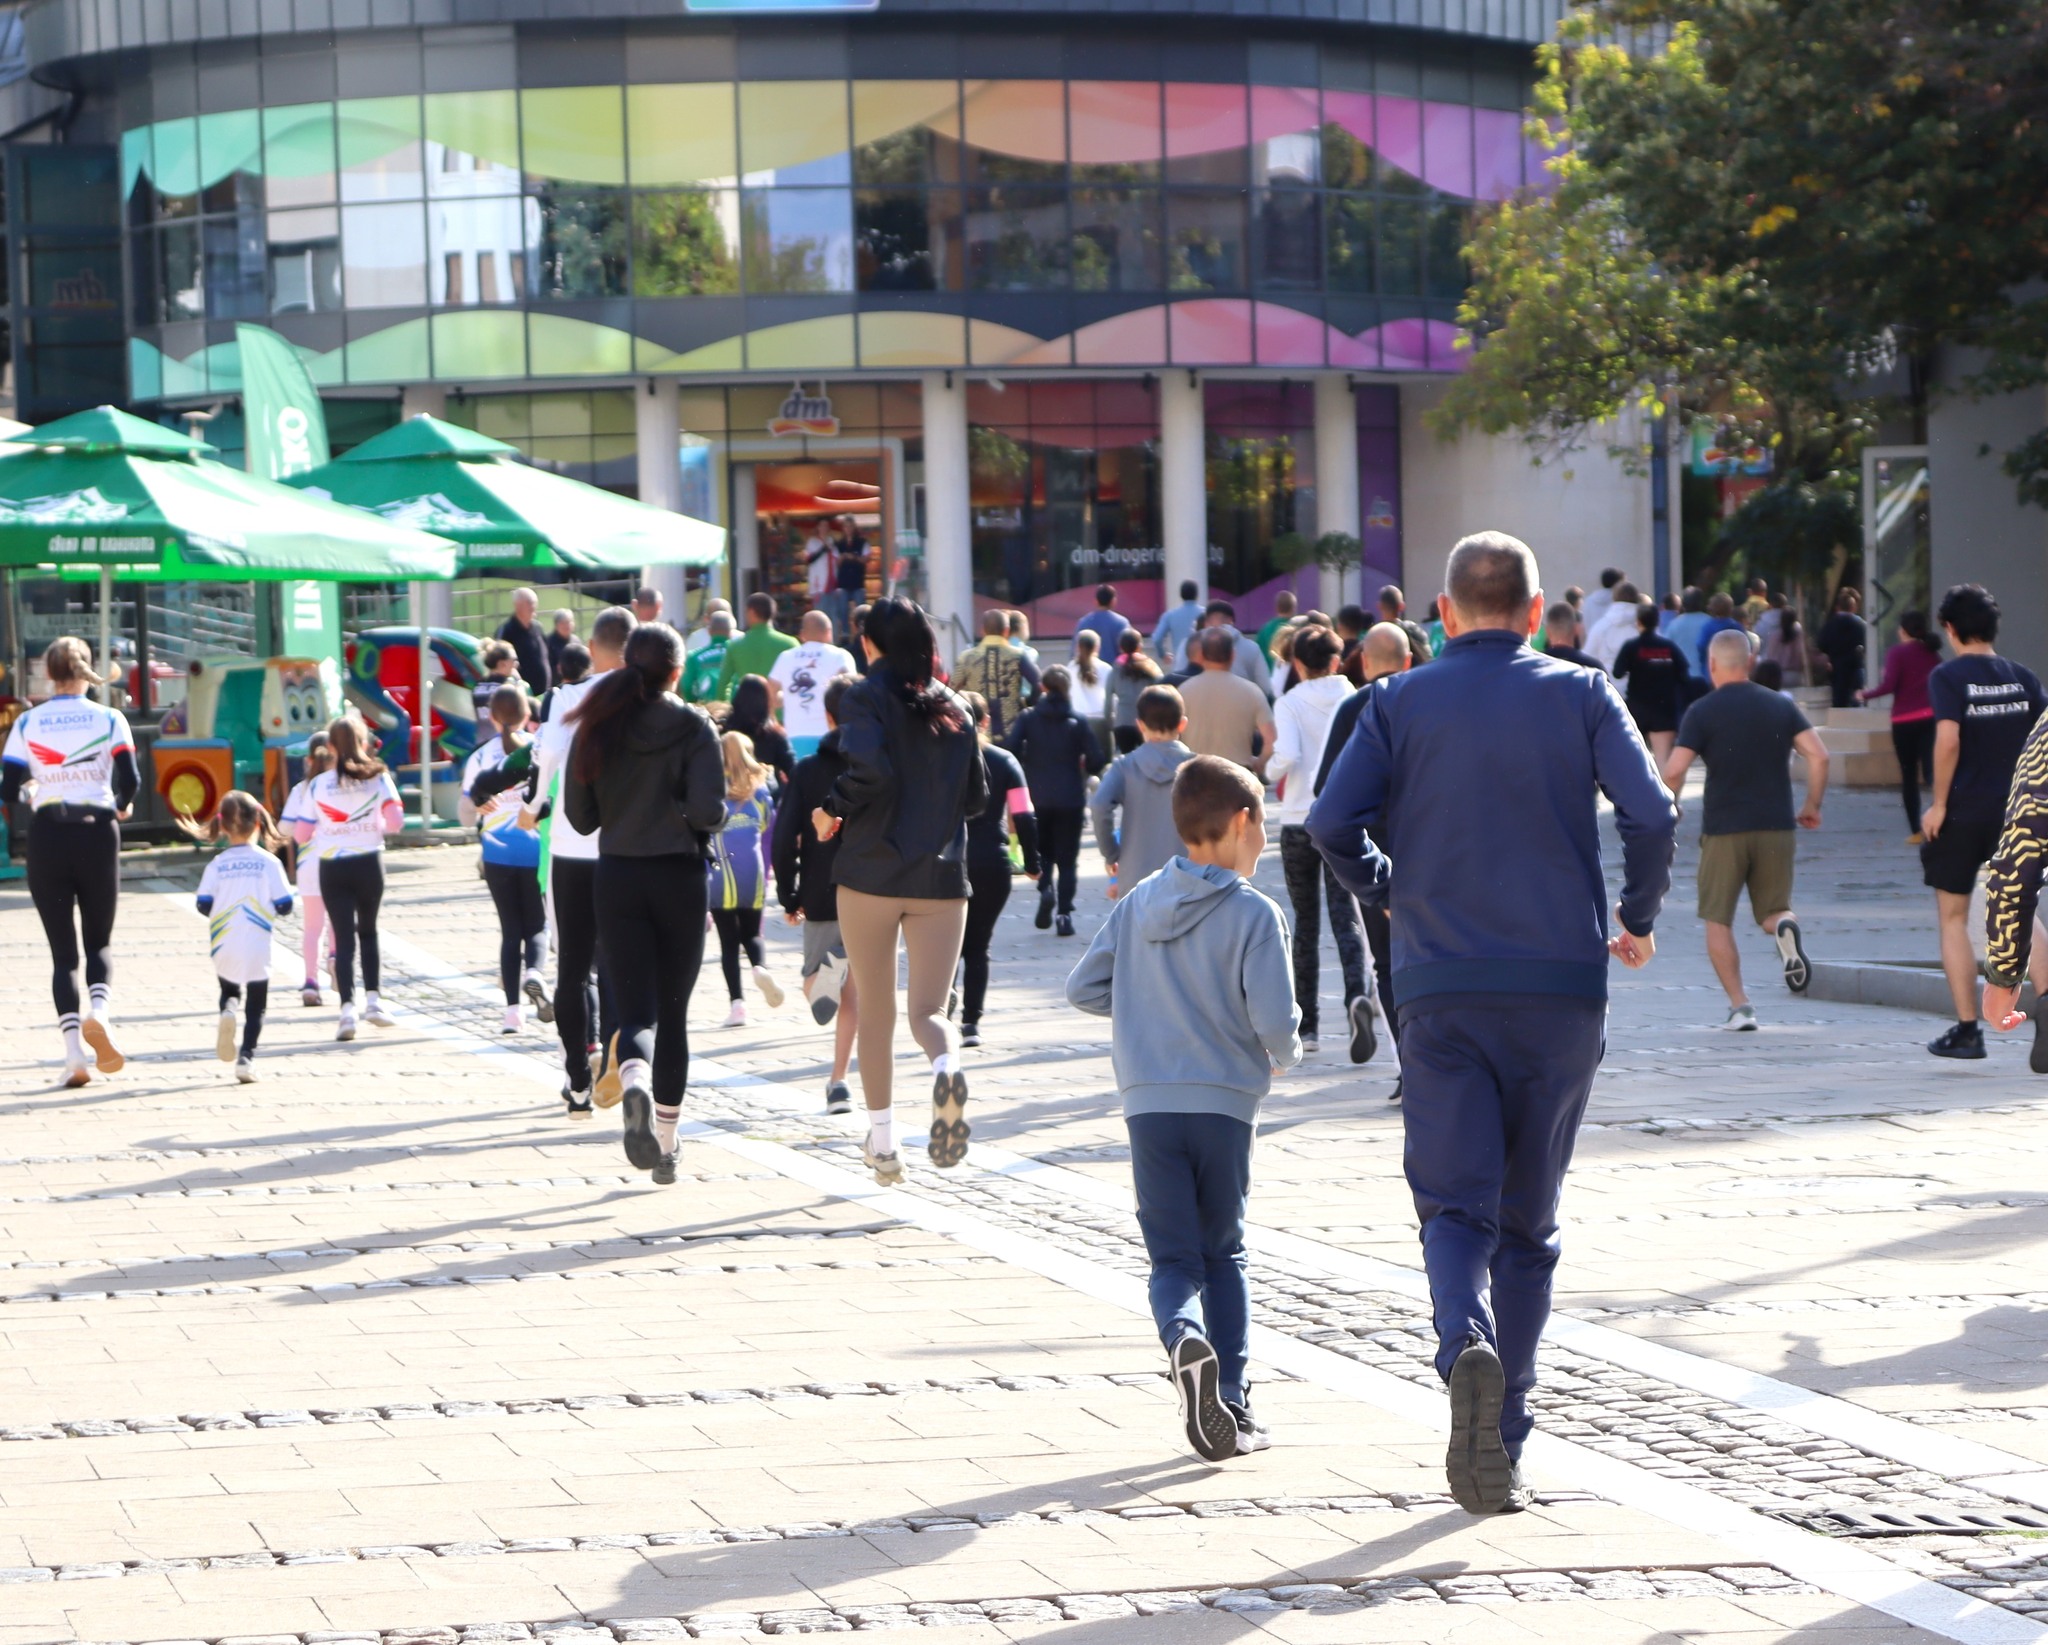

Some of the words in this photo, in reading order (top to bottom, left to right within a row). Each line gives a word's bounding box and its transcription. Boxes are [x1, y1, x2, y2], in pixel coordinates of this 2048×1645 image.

[782, 391, 829, 419] dm
[39, 714, 94, 727] MLADOST
[38, 769, 107, 785] EMIRATES
